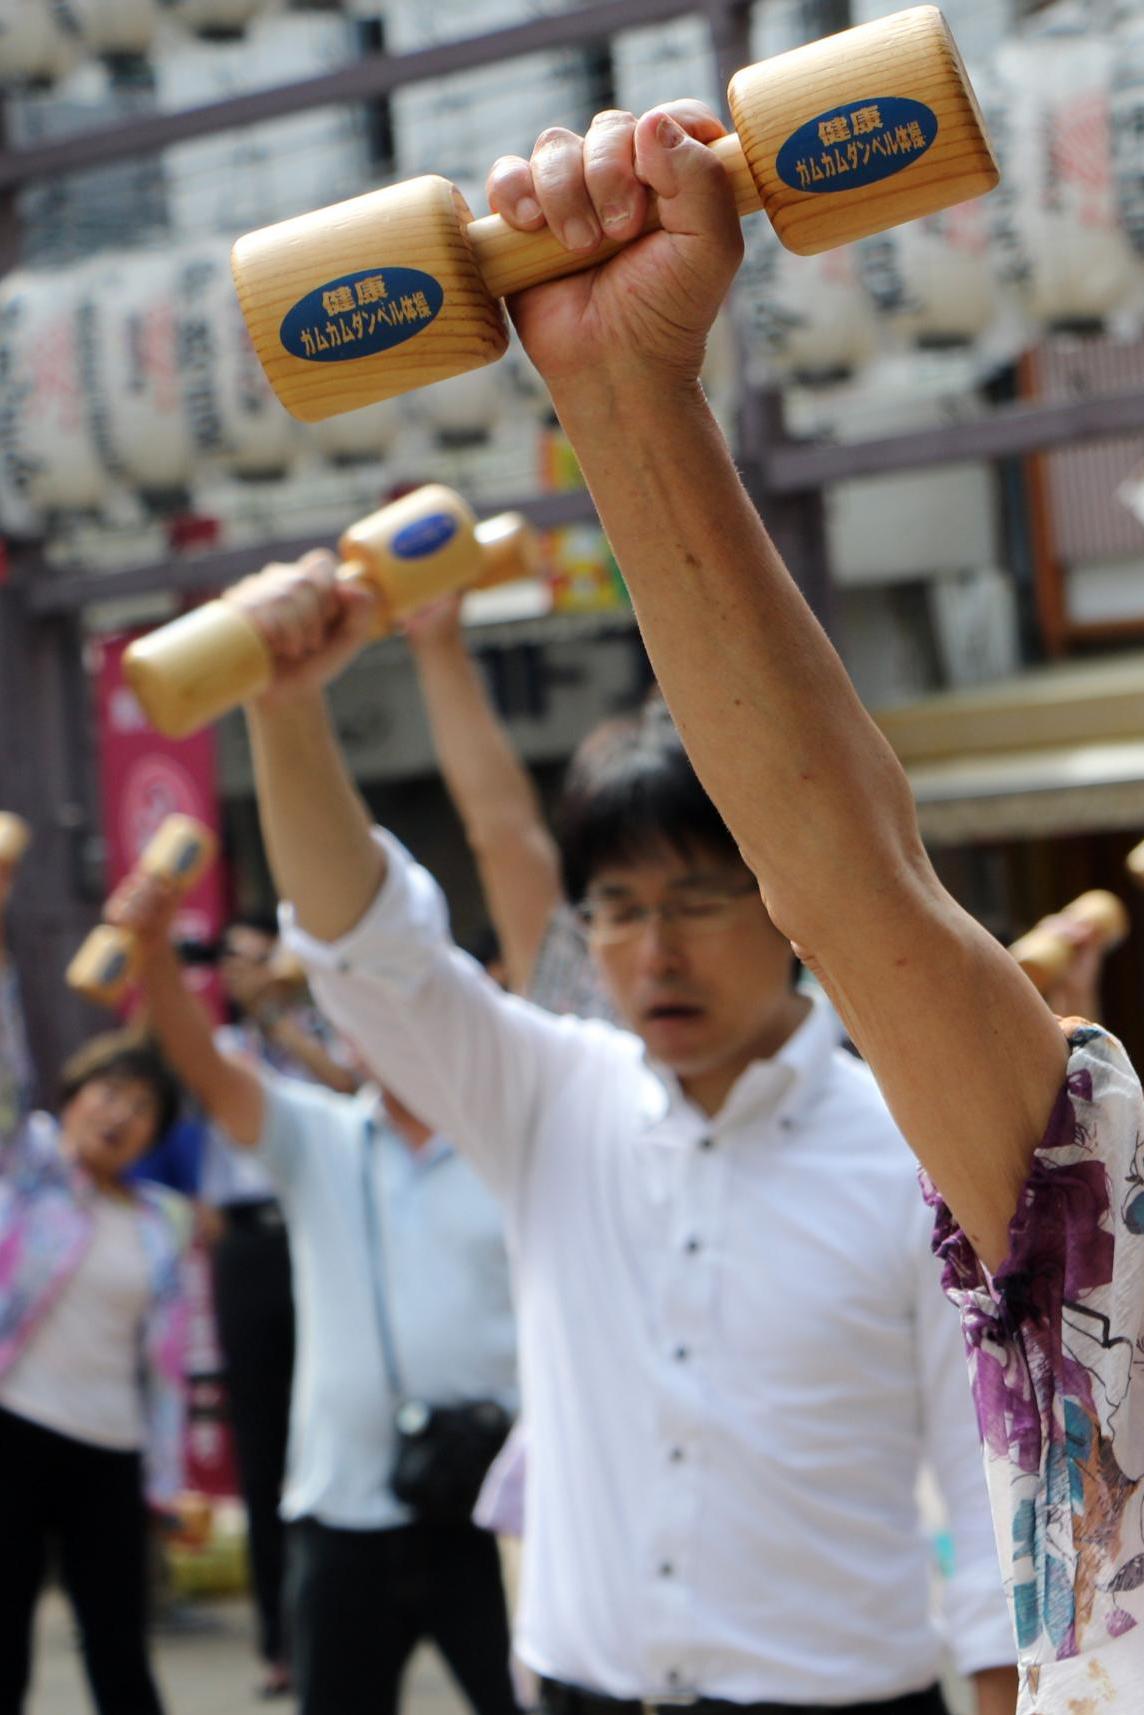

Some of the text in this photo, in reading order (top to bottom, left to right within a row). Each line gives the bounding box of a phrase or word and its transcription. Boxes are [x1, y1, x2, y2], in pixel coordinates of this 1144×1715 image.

[817, 104, 884, 147] 健康
[795, 119, 927, 190] ガムカムダンベル体操
[322, 273, 389, 317] 健康
[300, 290, 432, 358] ガムカムダンベル体操
